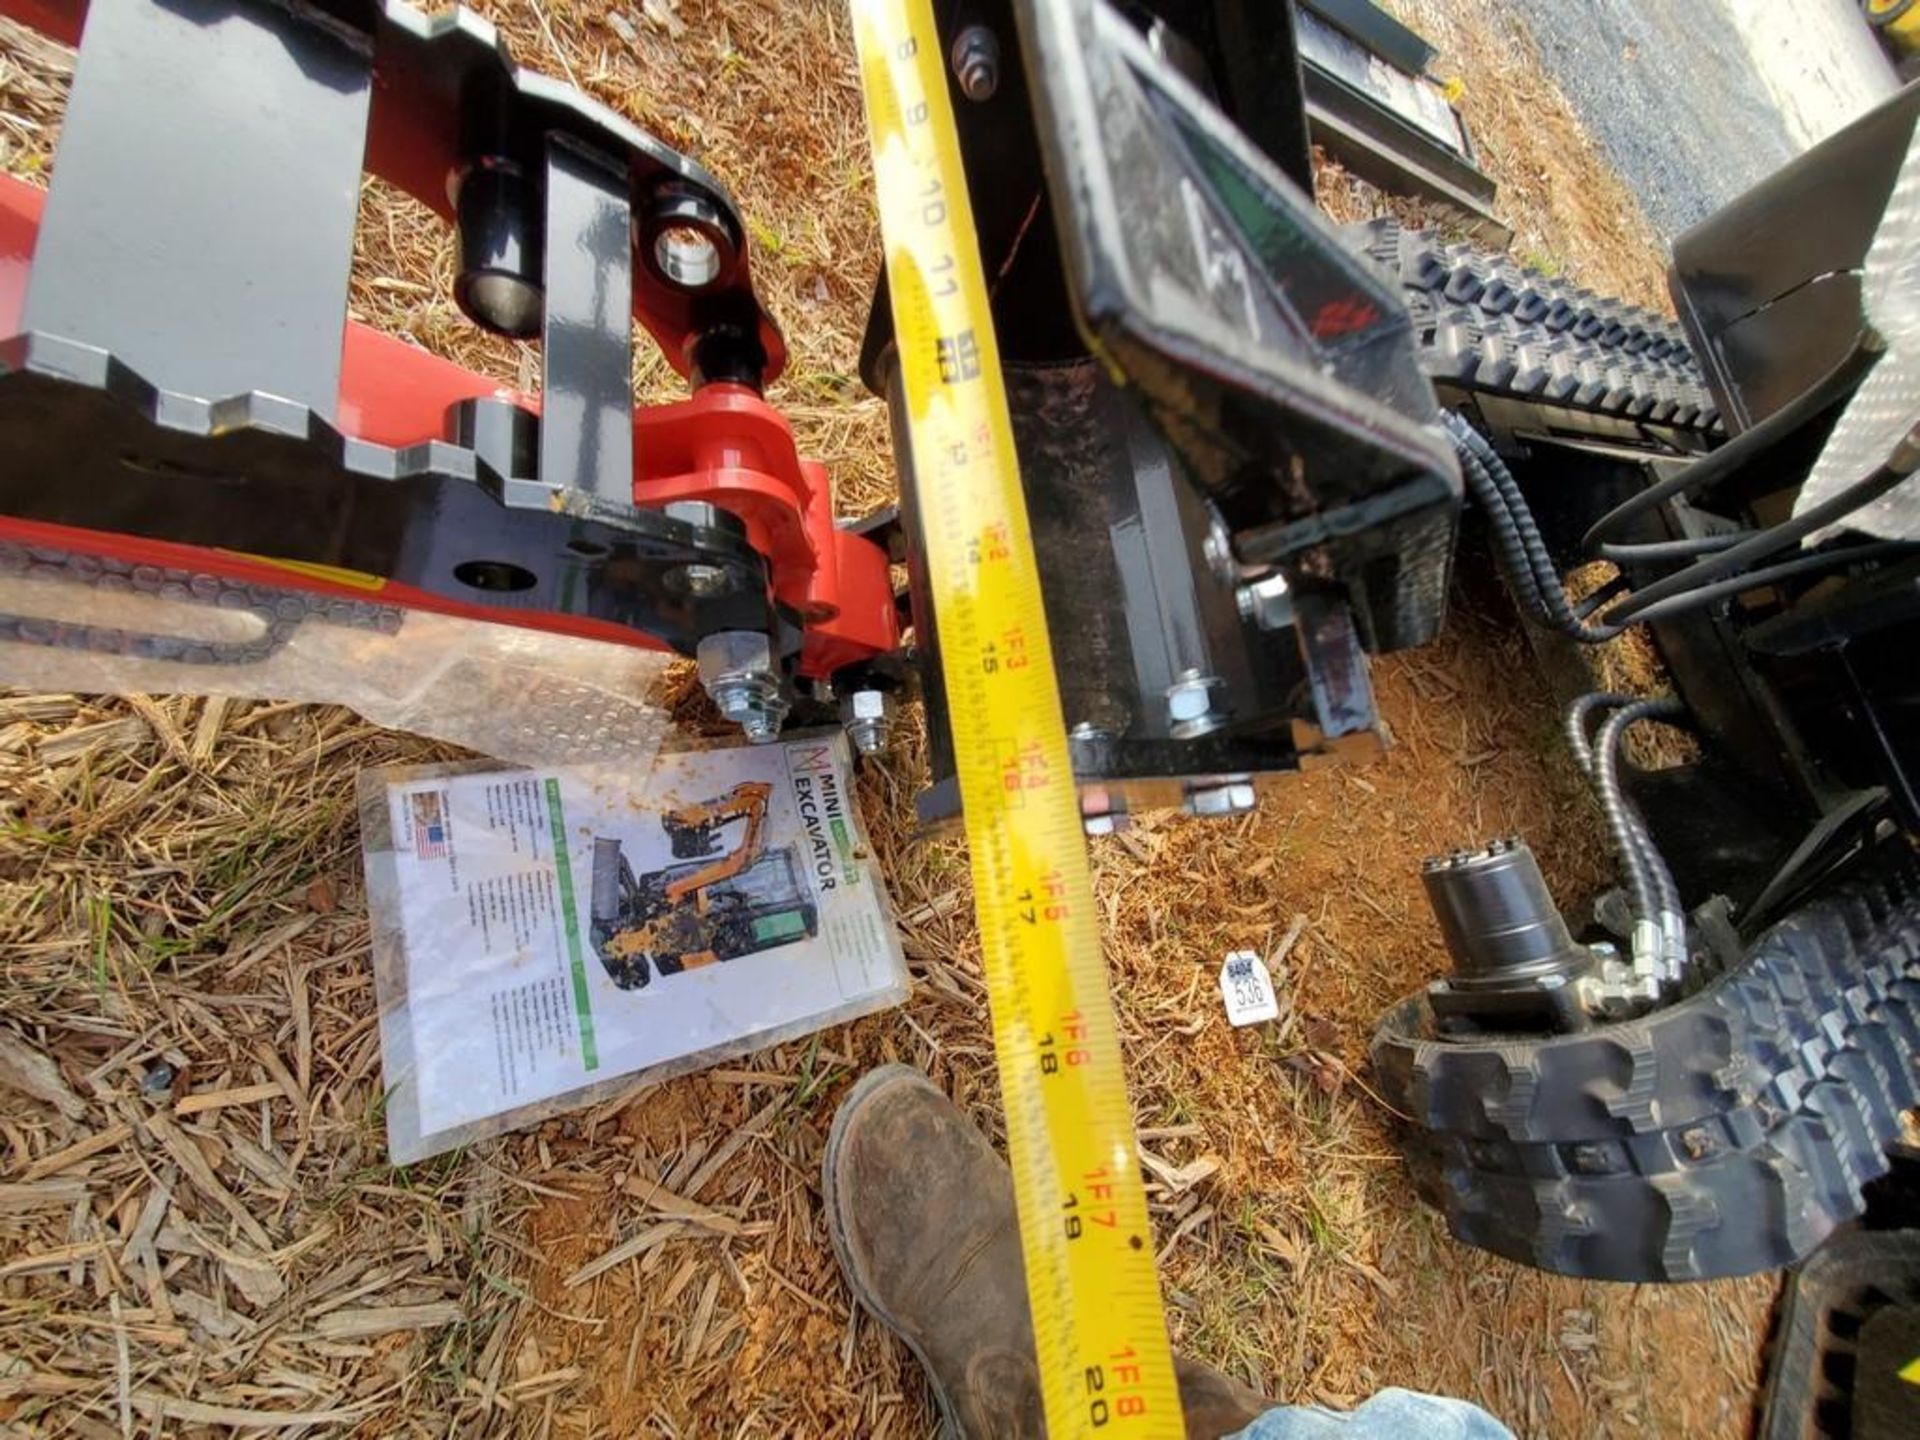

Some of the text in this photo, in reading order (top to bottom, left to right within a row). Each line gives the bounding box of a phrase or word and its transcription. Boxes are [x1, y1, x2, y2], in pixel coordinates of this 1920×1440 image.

[906, 101, 929, 127] 9
[919, 179, 947, 227] 10
[929, 253, 958, 298] 11
[981, 642, 998, 674] 15
[819, 773, 843, 819] MINI
[1002, 756, 1021, 792] 16
[793, 777, 837, 892] EXCAVATOR
[1018, 889, 1037, 925] 17
[1038, 1033, 1059, 1075] 18
[1062, 1193, 1083, 1240] 19
[1085, 1364, 1110, 1428] 20
